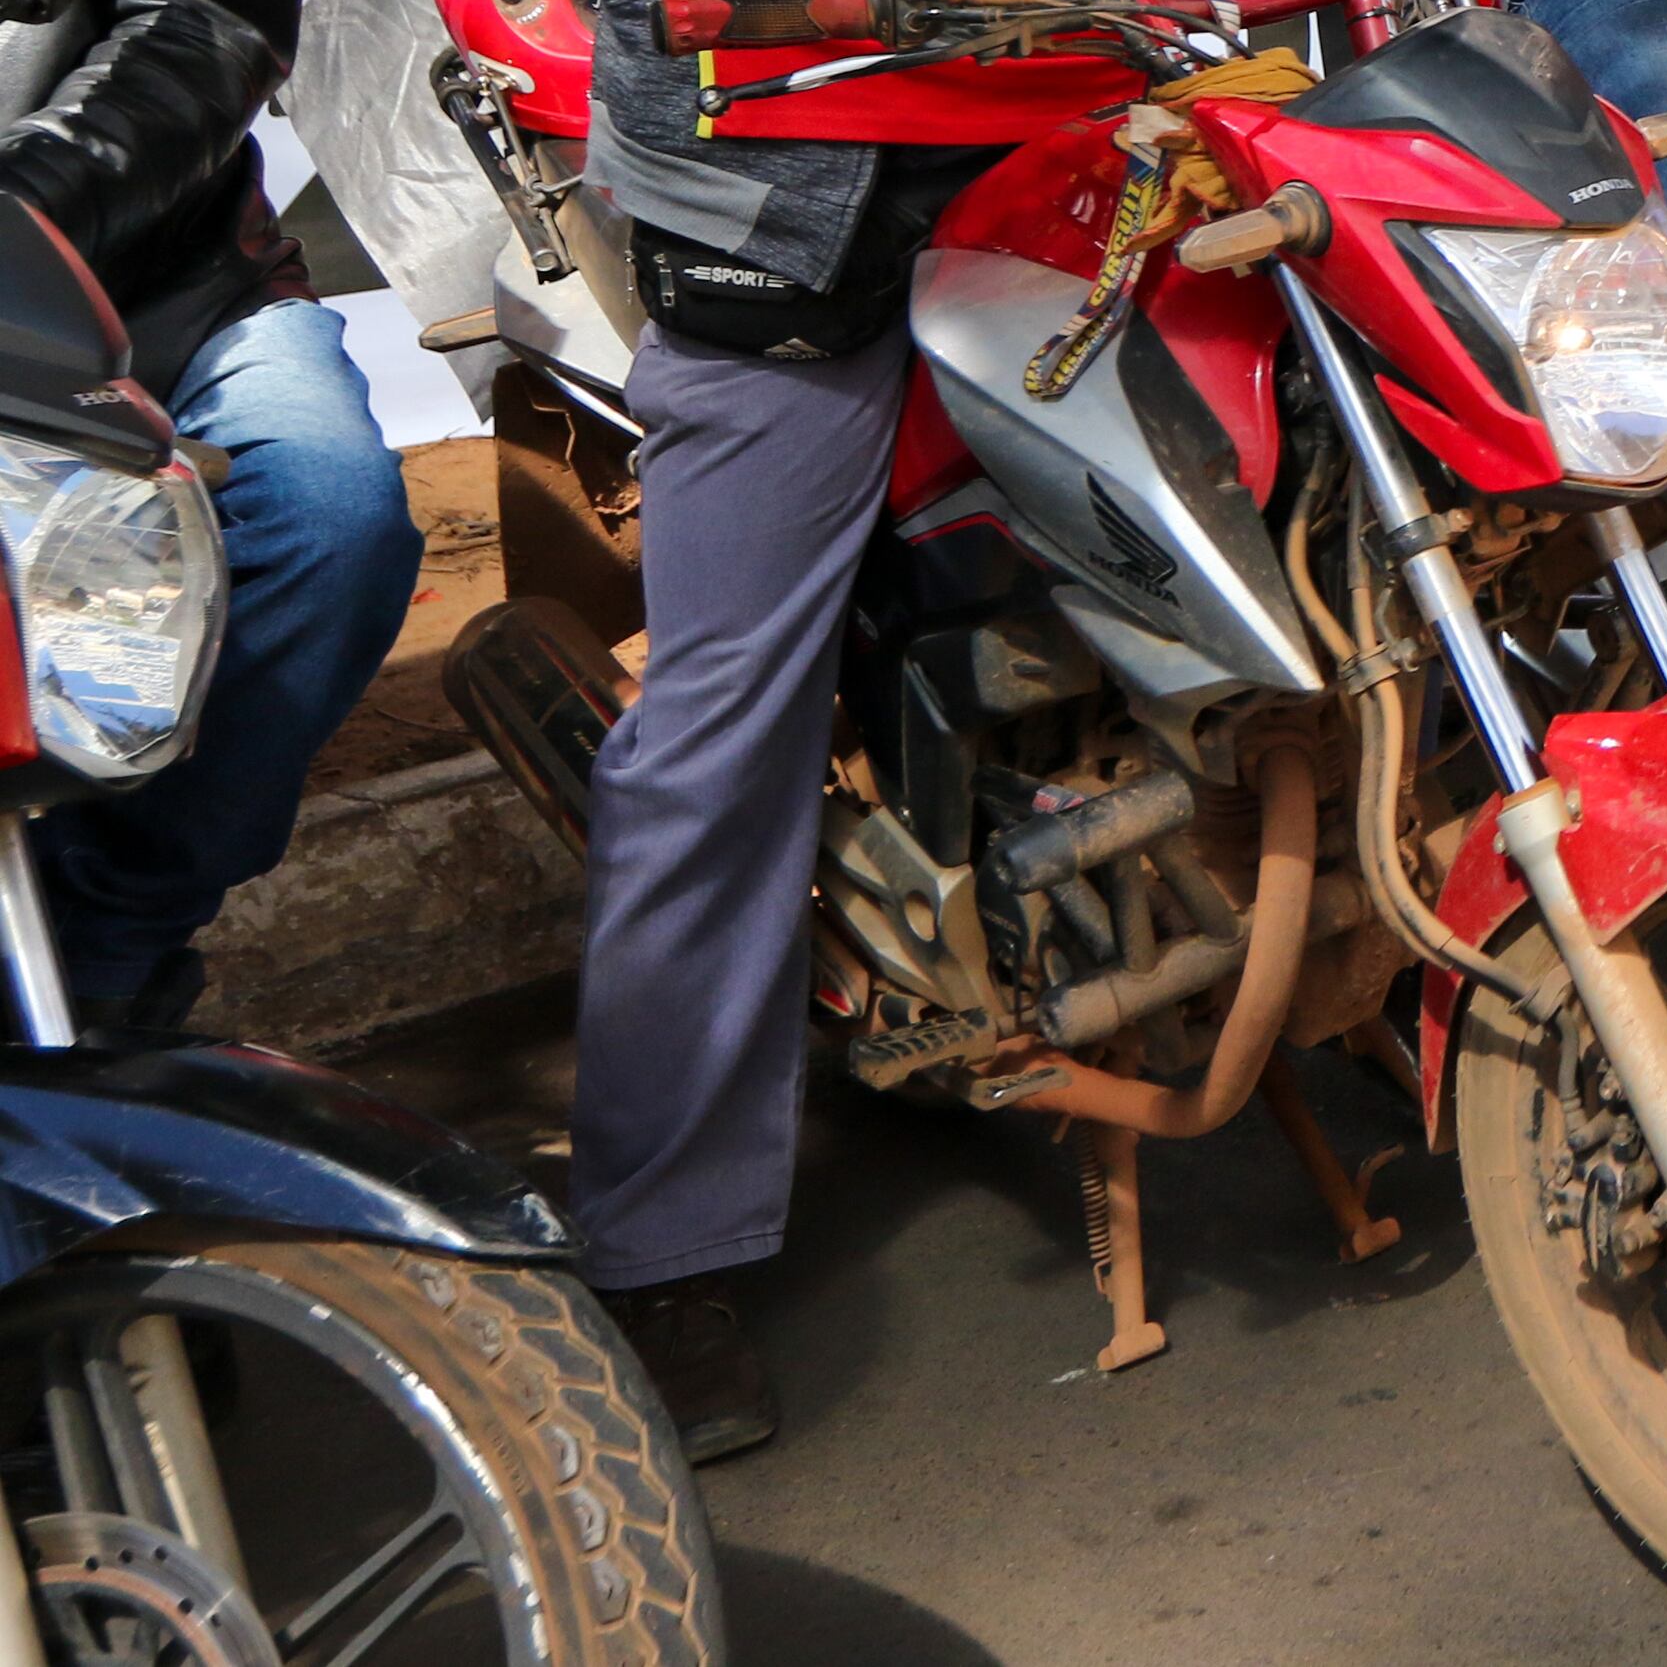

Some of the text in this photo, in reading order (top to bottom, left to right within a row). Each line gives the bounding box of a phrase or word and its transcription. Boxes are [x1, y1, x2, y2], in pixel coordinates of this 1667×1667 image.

[1568, 178, 1634, 204] HONDA
[711, 266, 767, 288] SPORT
[1088, 551, 1183, 611] HONDA
